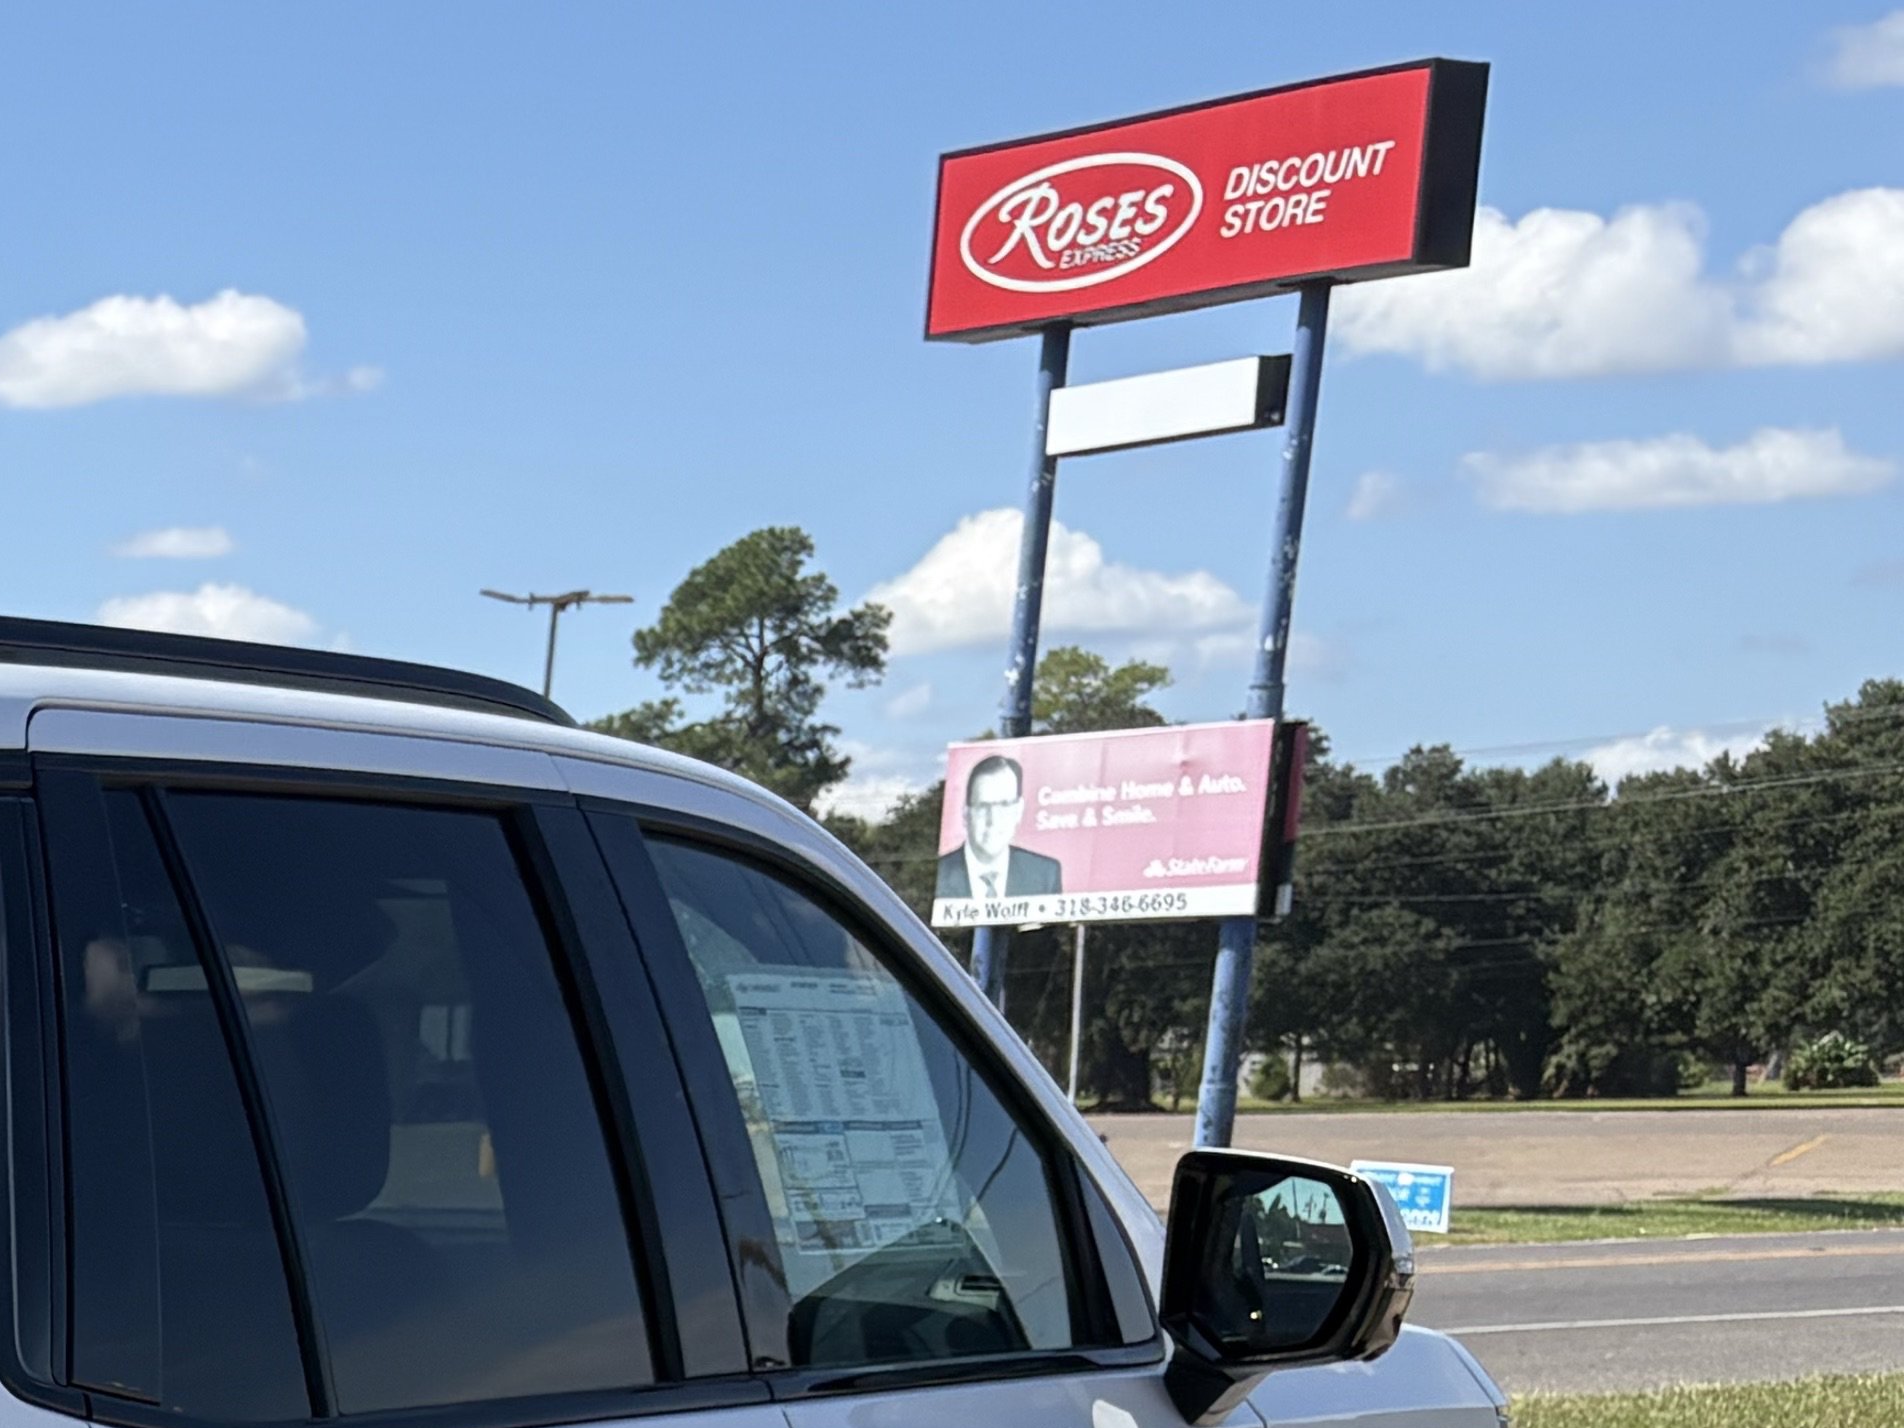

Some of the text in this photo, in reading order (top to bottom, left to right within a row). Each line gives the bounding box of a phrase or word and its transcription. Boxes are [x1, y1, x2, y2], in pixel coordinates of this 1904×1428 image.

[1224, 140, 1396, 201] DISCOUNT
[1220, 190, 1331, 239] STORE
[1060, 238, 1141, 270] EXPRESS
[1038, 773, 1248, 807] Combine Home & Auto.
[1036, 804, 1157, 831] Save & Smile.
[942, 903, 979, 921] Kyle
[1055, 893, 1188, 917] 318-346-6695
